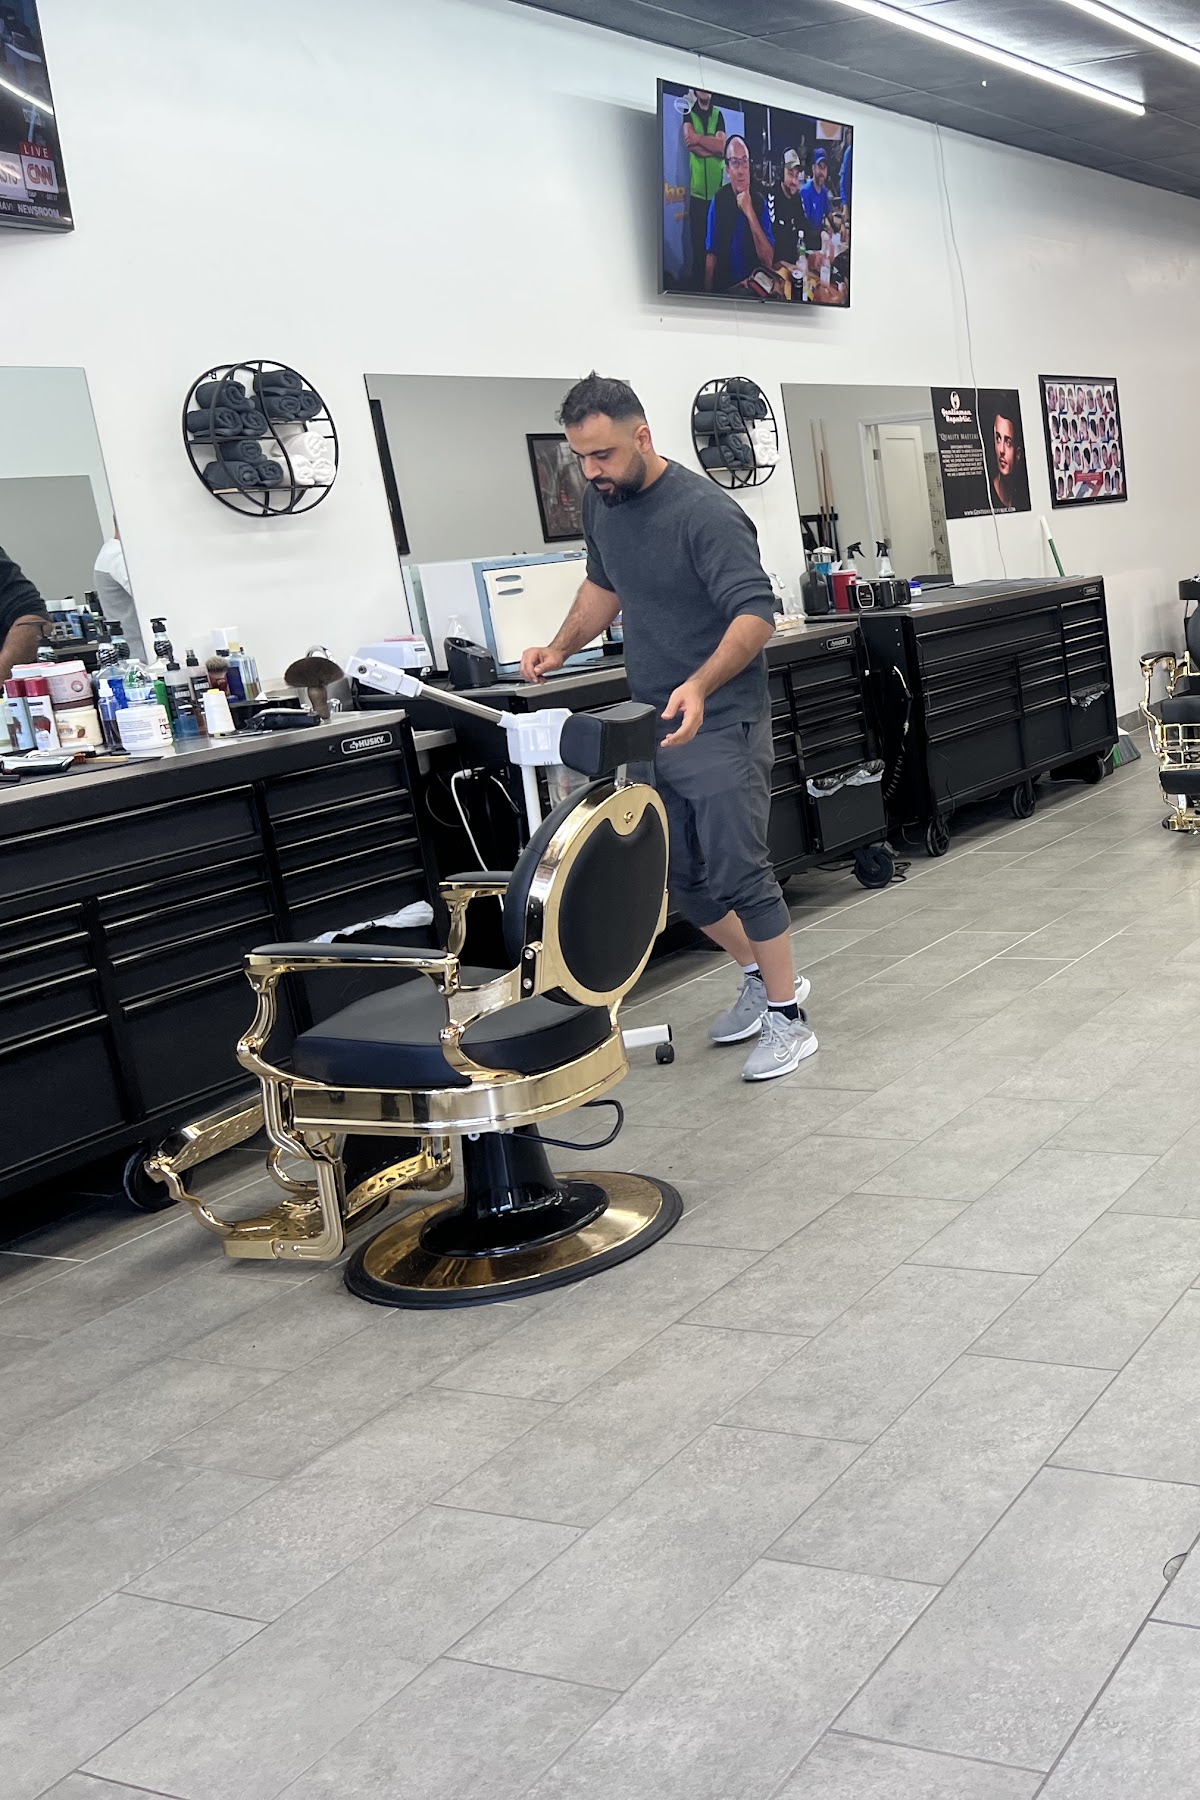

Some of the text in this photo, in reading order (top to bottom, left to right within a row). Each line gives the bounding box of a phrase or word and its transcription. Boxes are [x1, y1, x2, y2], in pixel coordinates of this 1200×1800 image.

[23, 144, 49, 158] LIVE
[27, 163, 54, 186] CNN
[17, 203, 60, 219] NEWSROOM
[358, 735, 386, 748] HUSKY
